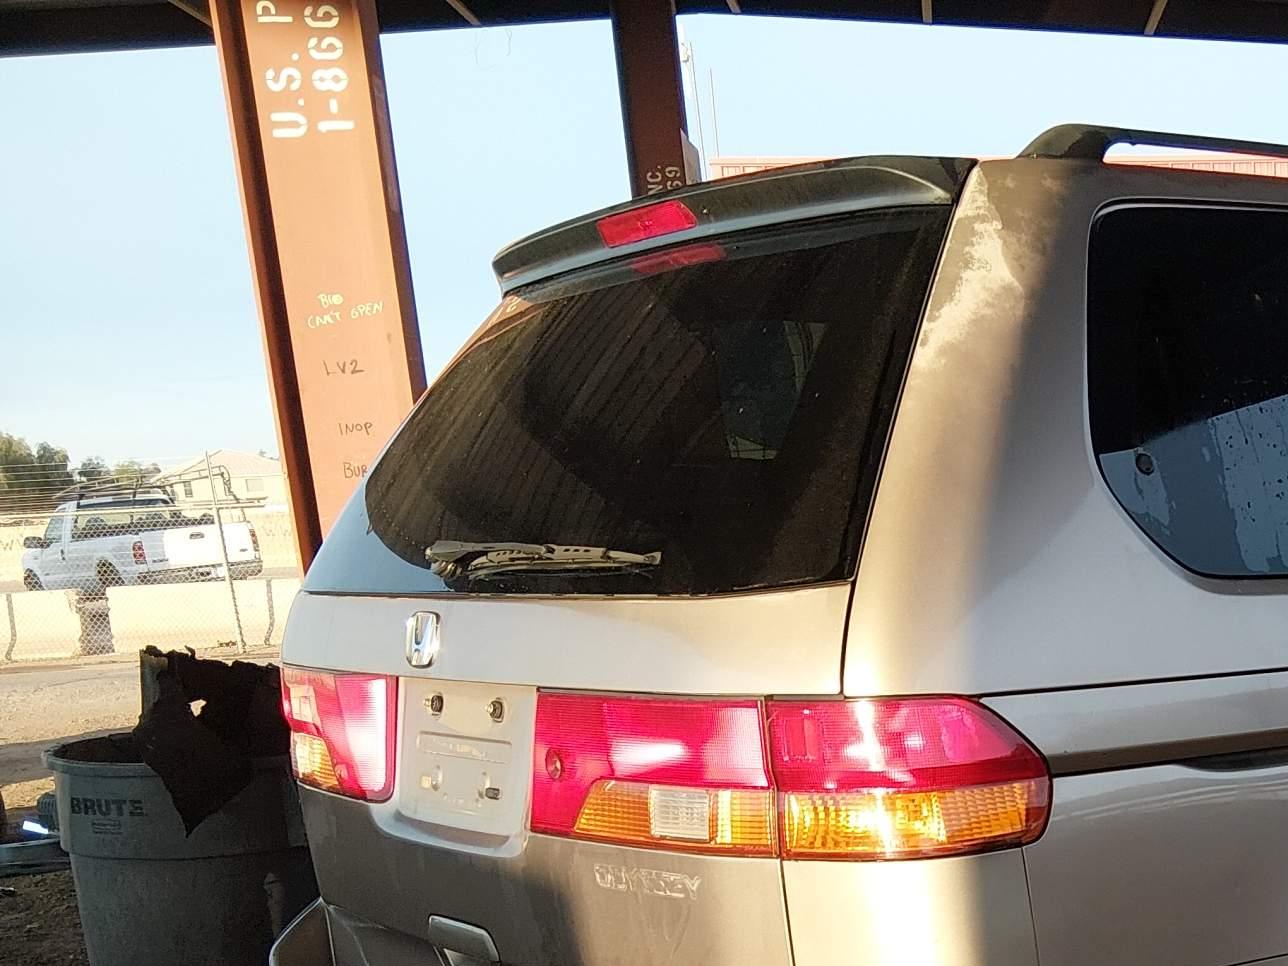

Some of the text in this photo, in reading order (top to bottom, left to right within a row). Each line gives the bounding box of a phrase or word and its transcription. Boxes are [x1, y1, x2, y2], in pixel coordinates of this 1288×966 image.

[303, 4, 356, 134] 1-866
[264, 52, 309, 139] U.S.
[350, 301, 383, 319] OPEN
[338, 421, 374, 436] INOP
[71, 796, 145, 818] BRUTE
